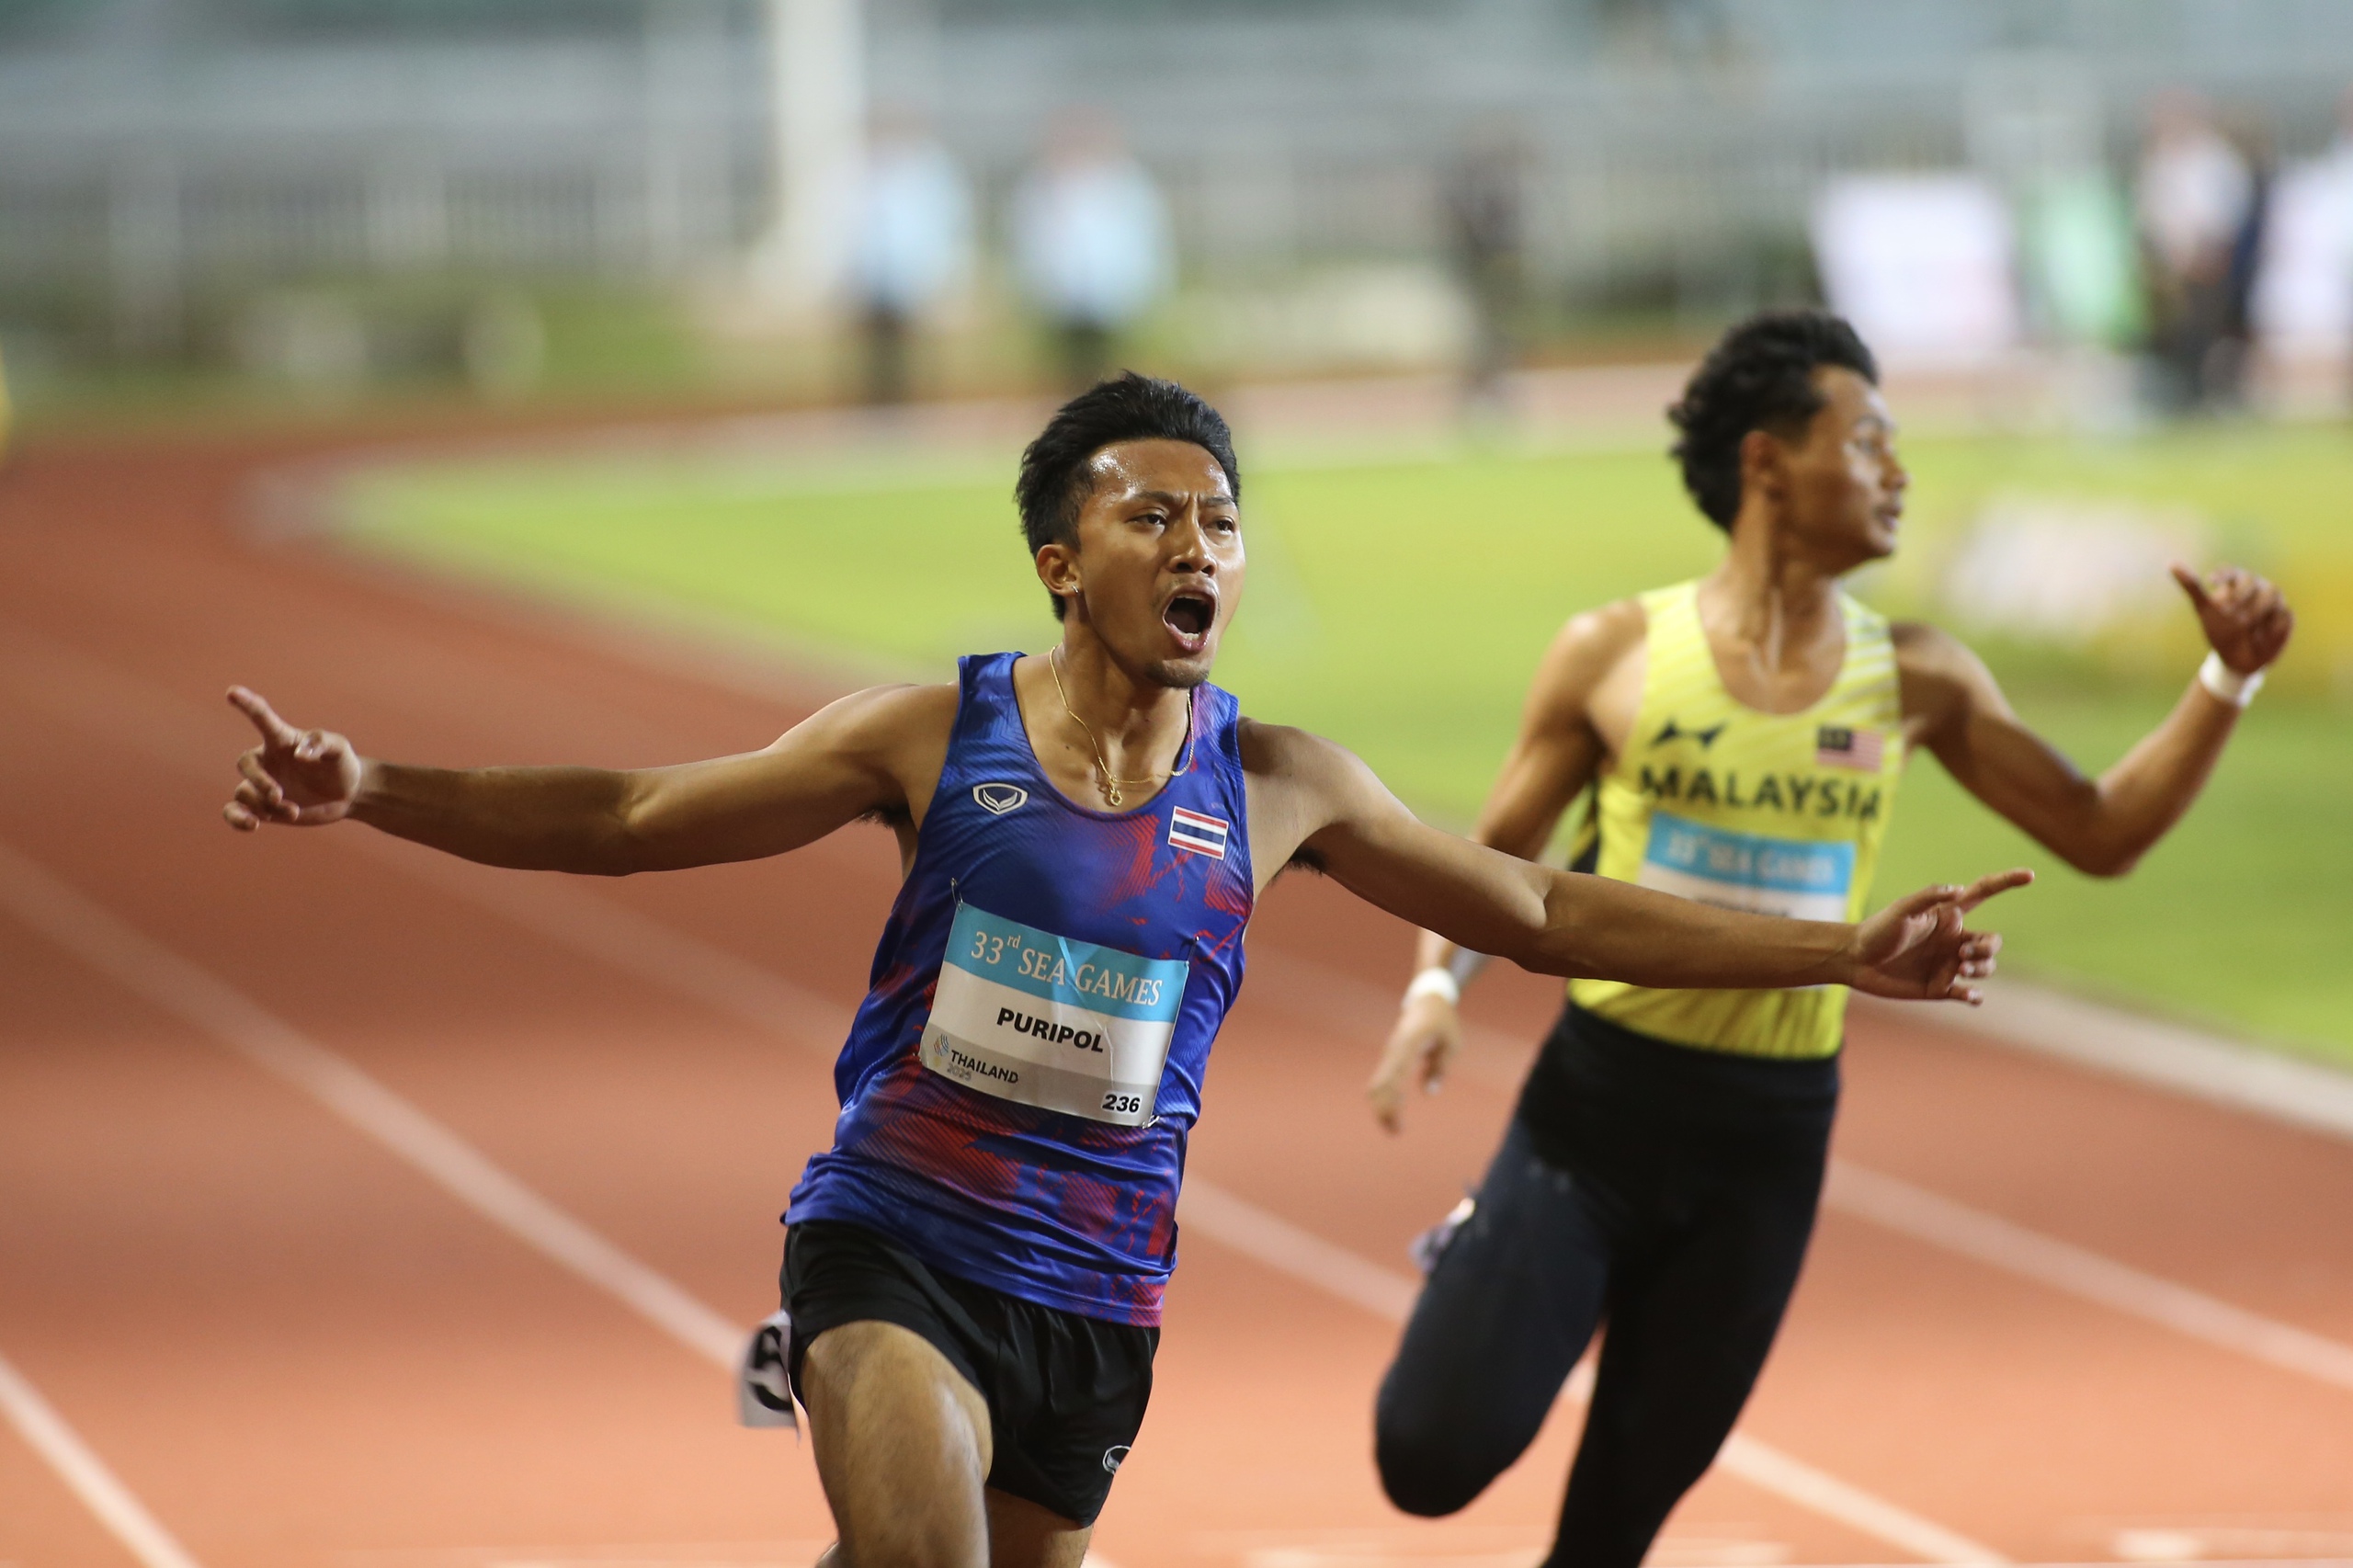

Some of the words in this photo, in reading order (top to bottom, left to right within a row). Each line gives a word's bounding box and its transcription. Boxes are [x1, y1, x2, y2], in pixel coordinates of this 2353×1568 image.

[1640, 767, 1881, 818] MALAYSIA
[1017, 948, 1065, 985] SEA
[1075, 963, 1163, 1006] GAMES
[996, 1007, 1104, 1053] PURIPOL
[950, 1050, 1019, 1084] THAILAND
[1102, 1094, 1140, 1113] 236
